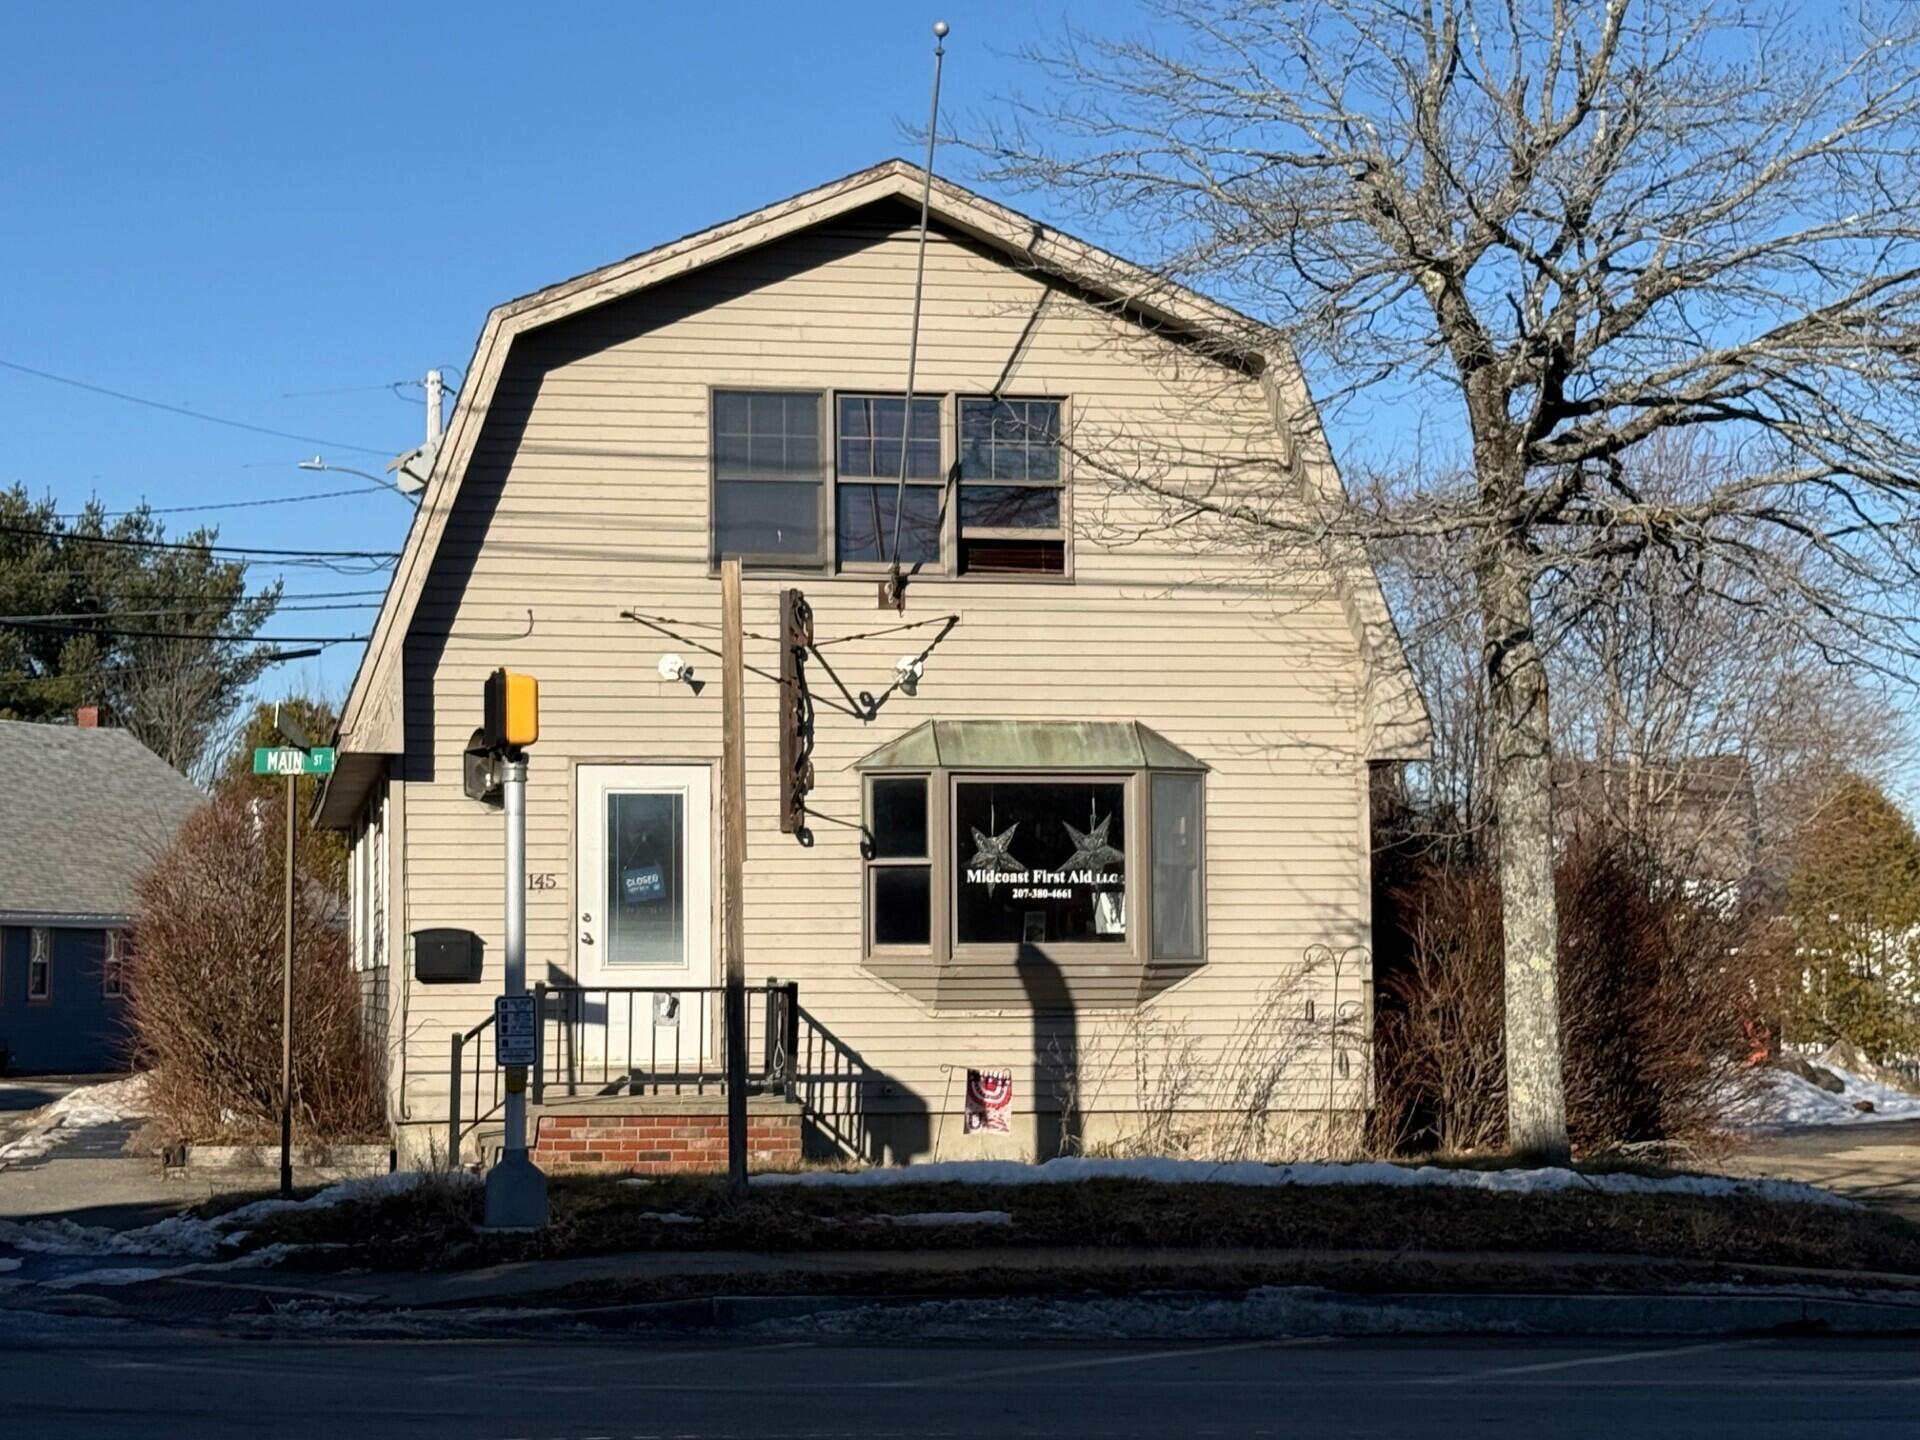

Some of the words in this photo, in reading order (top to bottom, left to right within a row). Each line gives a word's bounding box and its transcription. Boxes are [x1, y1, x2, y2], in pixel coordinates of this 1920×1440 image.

[267, 751, 303, 770] MAIN
[313, 754, 324, 766] ST
[528, 873, 557, 890] 145
[626, 873, 659, 888] CLOSED
[966, 869, 1029, 884] Midcoast
[1033, 869, 1065, 884] First
[1068, 869, 1092, 884] Aid
[1012, 888, 1072, 899] 207-380-4661
